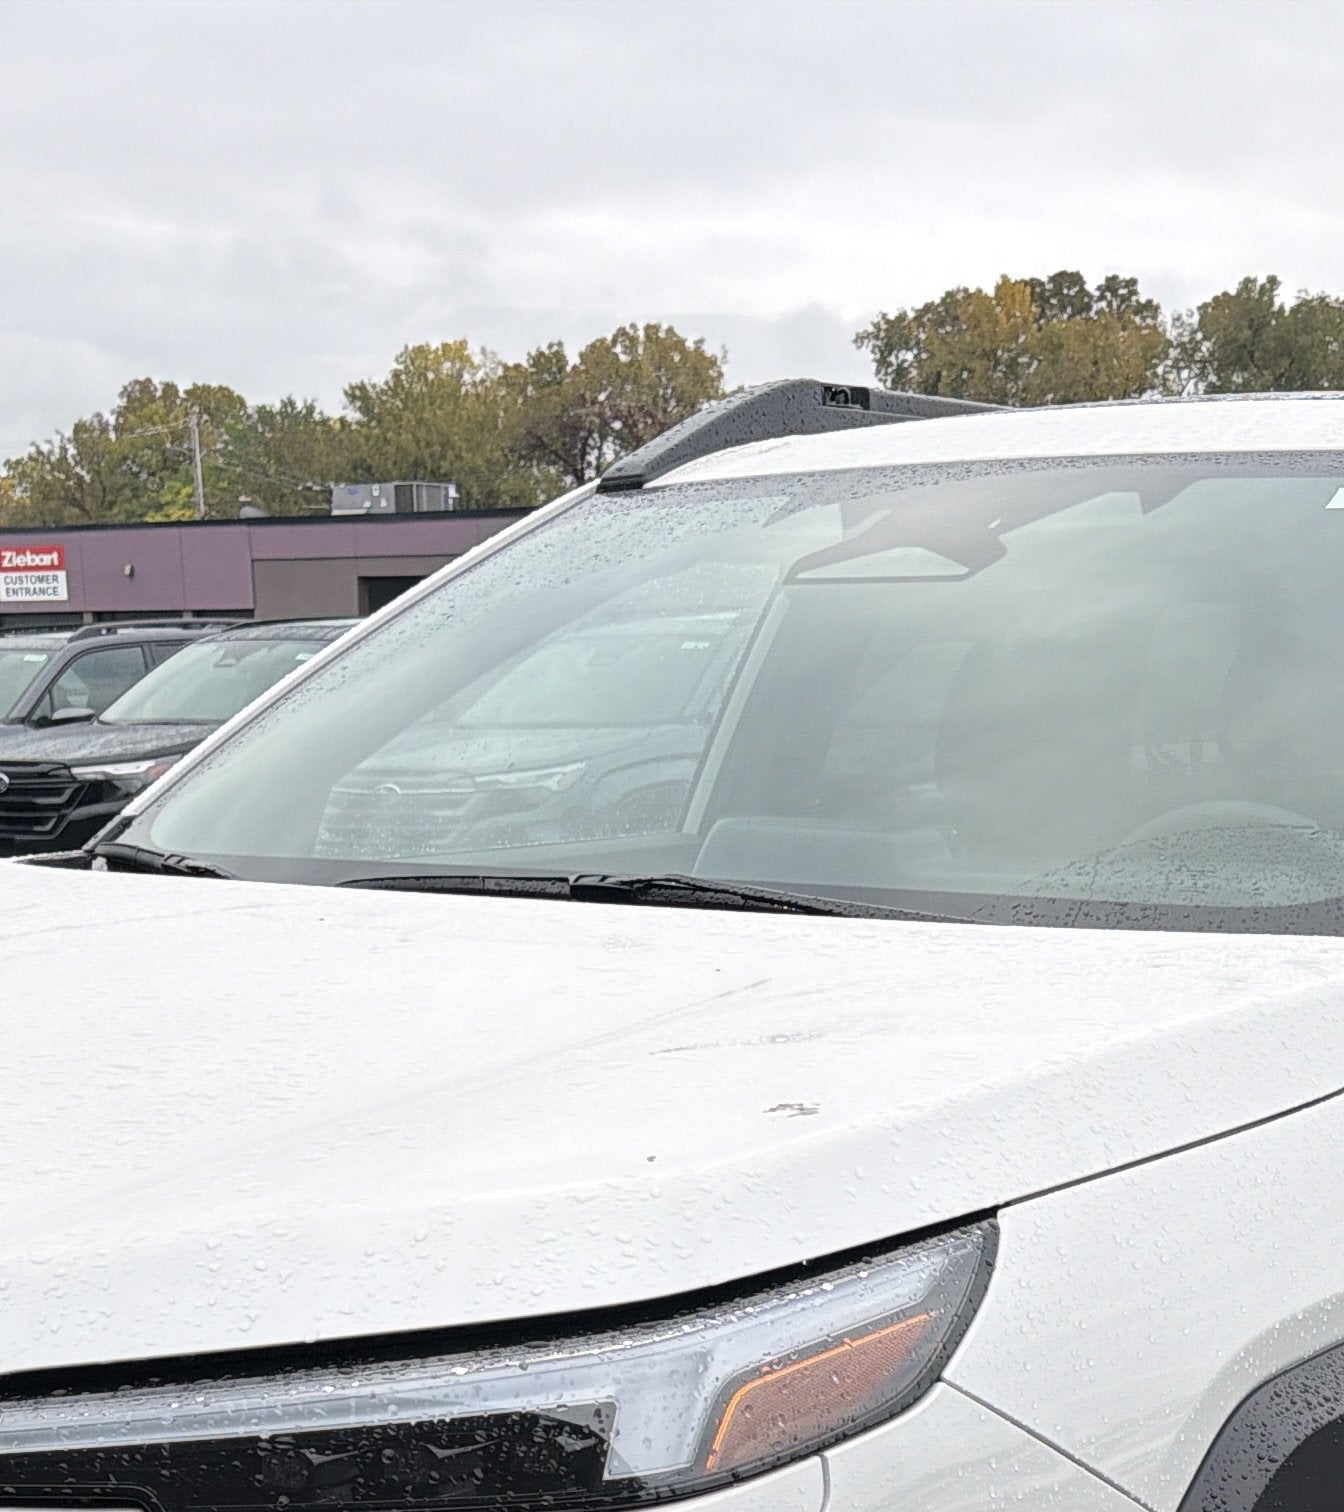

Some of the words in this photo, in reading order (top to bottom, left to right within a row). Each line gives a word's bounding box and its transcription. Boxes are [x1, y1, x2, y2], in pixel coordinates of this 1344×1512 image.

[1, 549, 59, 567] Ziebart
[3, 574, 59, 585] CUSTOMER
[5, 586, 59, 597] ENTRANCE
